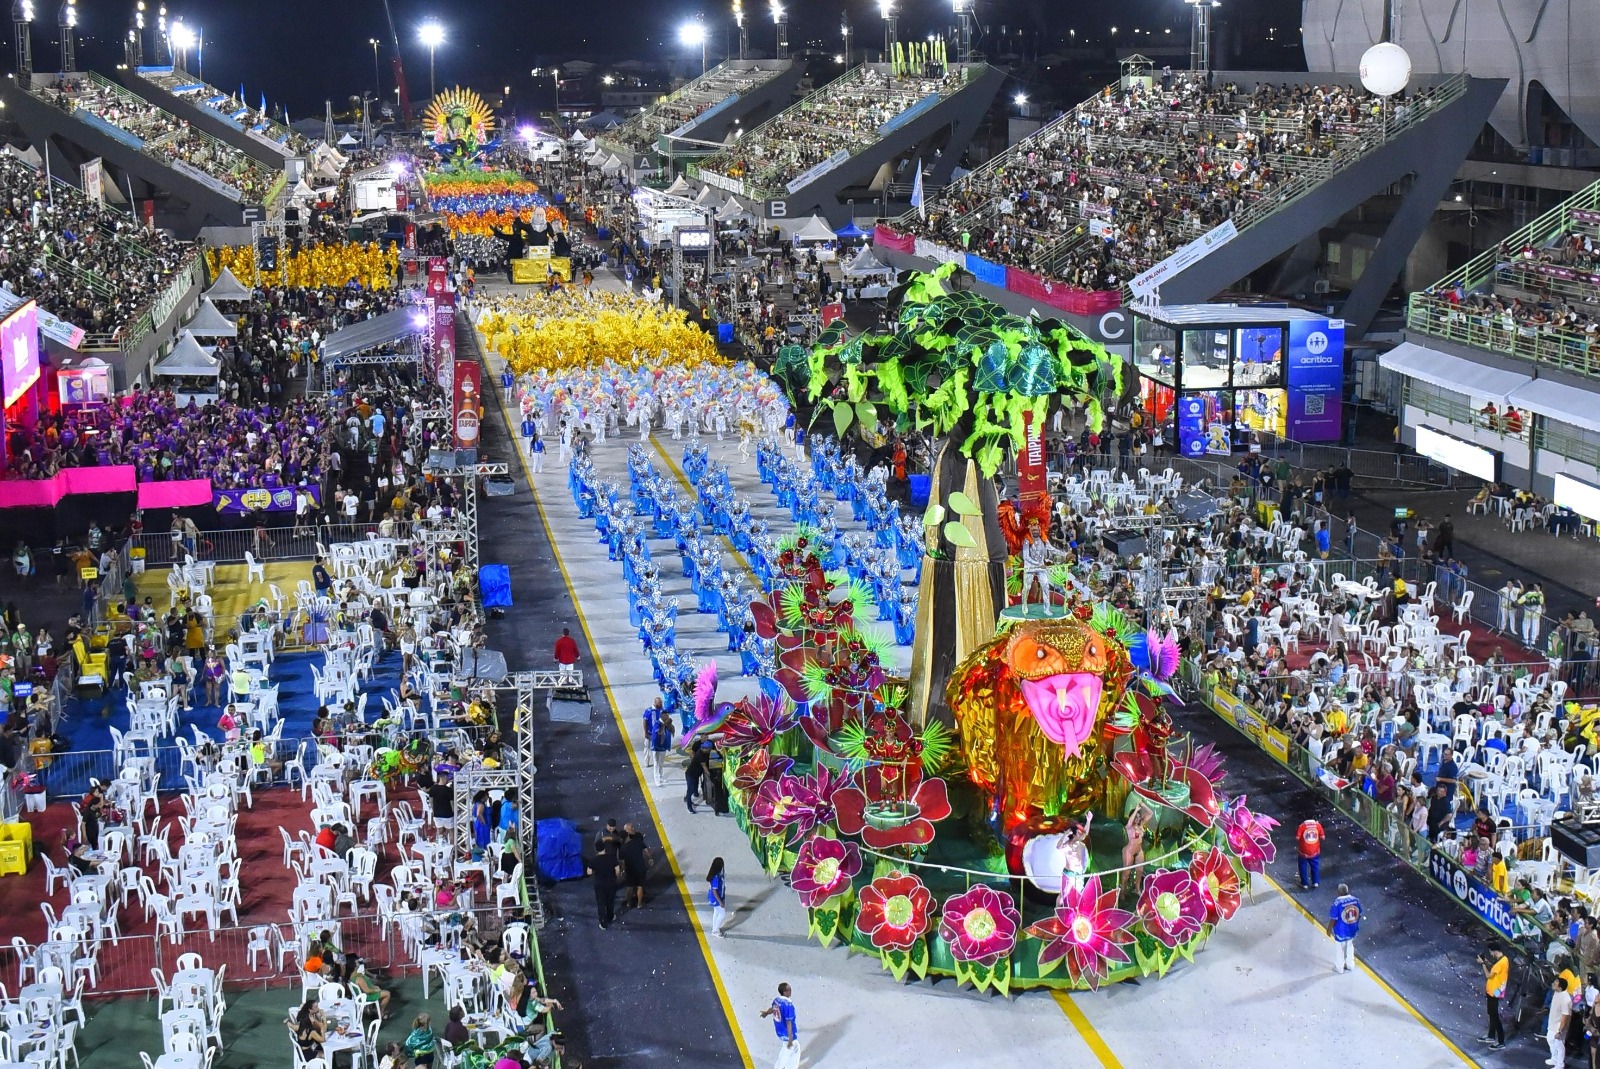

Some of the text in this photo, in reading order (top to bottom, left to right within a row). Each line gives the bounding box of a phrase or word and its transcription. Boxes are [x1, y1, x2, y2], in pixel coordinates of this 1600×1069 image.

[641, 158, 650, 168] A
[242, 208, 258, 224] F
[771, 201, 786, 216] B
[1099, 311, 1125, 339] C
